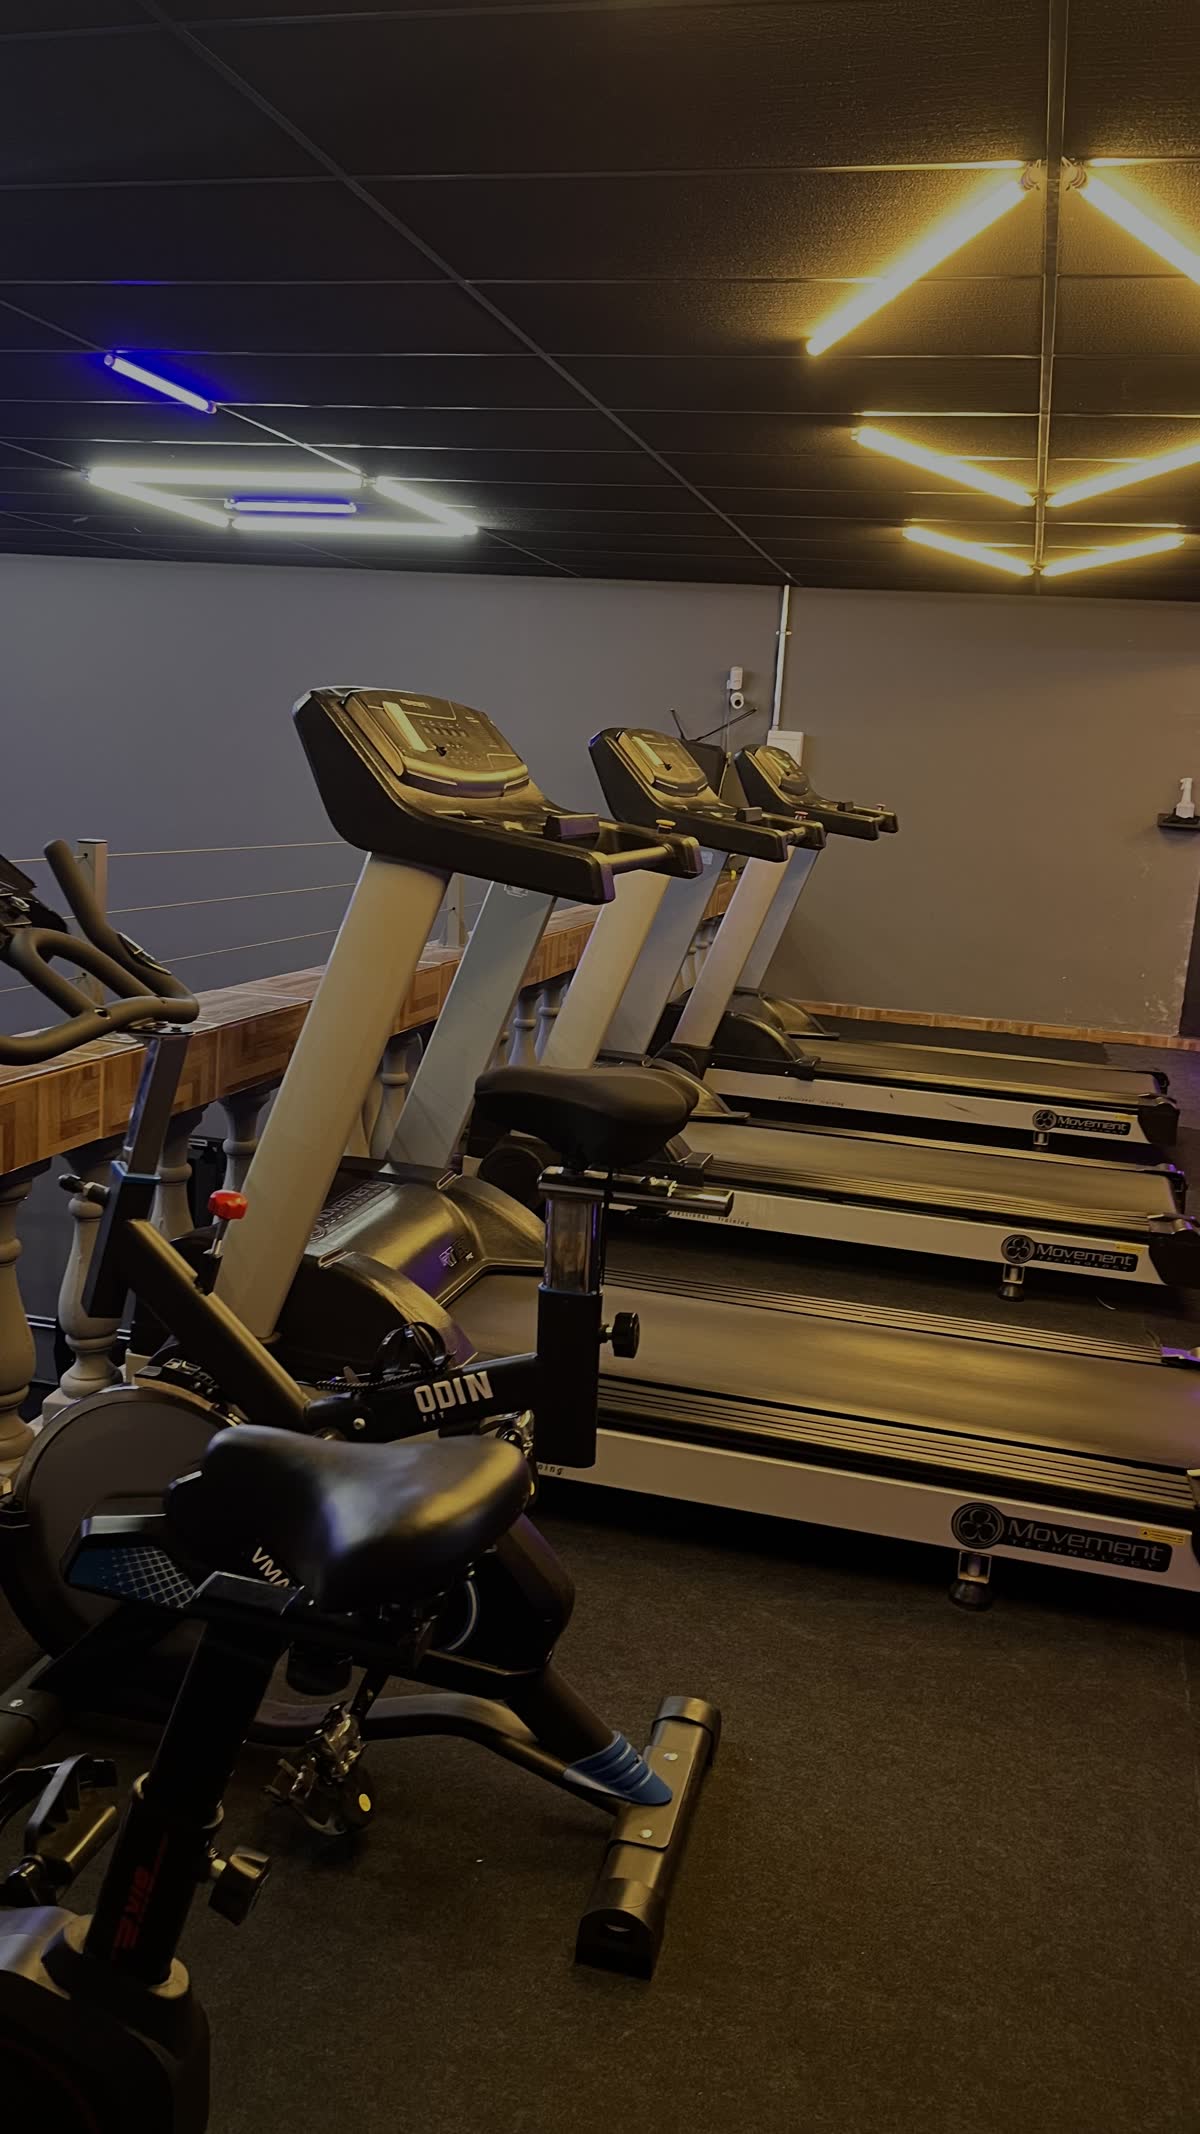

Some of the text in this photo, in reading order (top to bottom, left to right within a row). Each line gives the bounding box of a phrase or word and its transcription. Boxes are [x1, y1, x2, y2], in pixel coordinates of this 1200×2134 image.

[1057, 1116, 1129, 1131] Movement
[1036, 1244, 1135, 1266] Movement
[413, 1371, 494, 1413] ODIN
[1007, 1519, 1162, 1562] Movement
[1012, 1537, 1161, 1568] TECHNOLOGY
